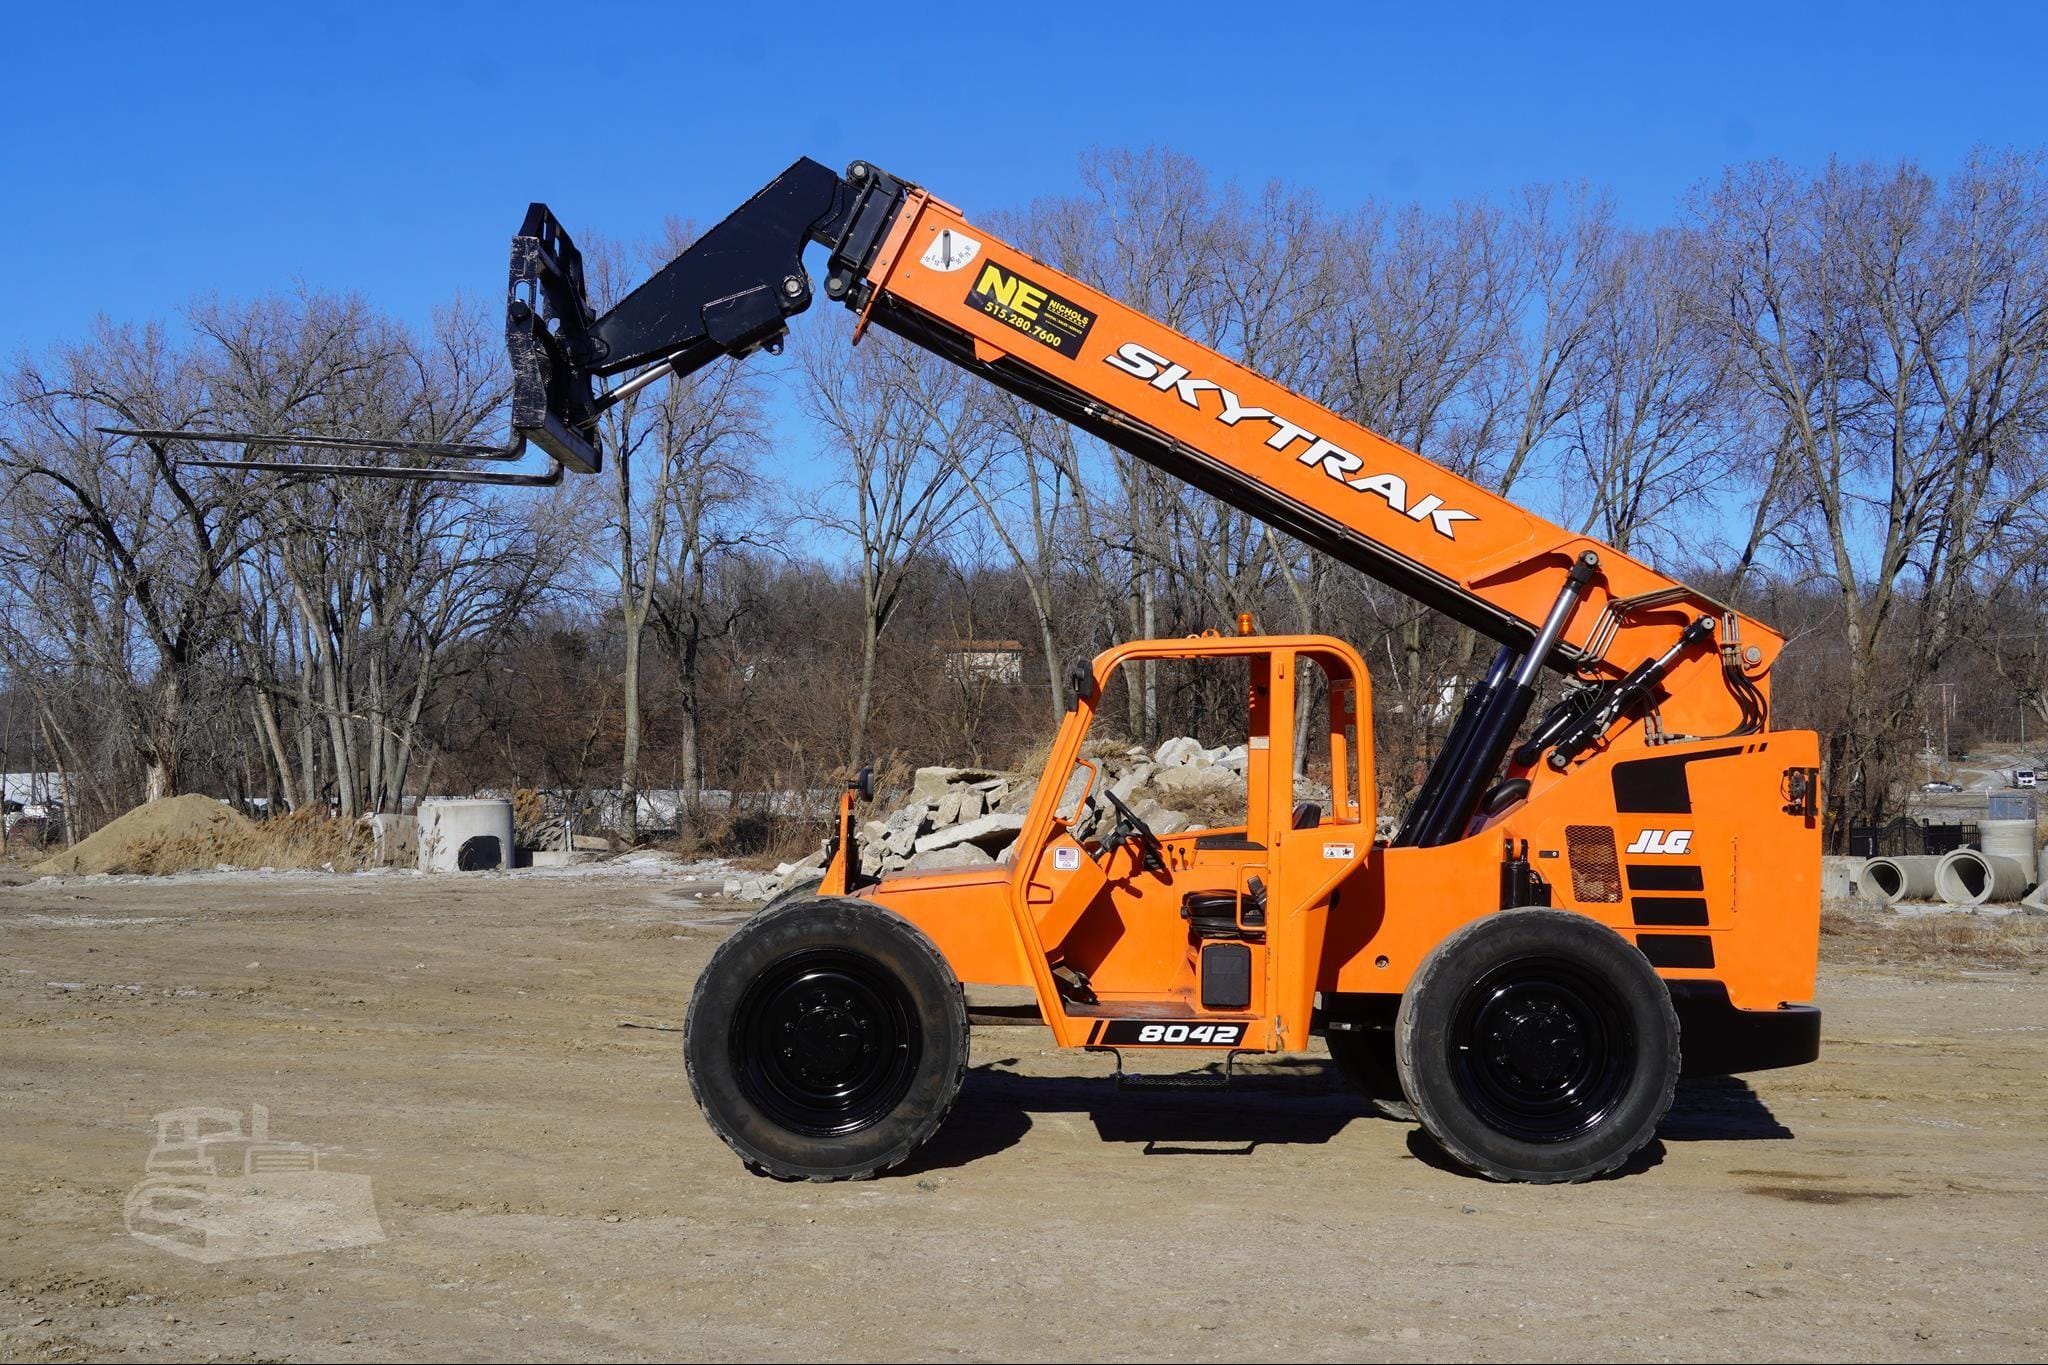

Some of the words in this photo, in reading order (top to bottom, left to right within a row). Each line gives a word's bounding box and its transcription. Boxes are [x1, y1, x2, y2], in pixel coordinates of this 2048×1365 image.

[976, 265, 1048, 321] NE
[984, 301, 1061, 347] 515.280.7600
[1048, 299, 1089, 325] NICHOLS
[1103, 342, 1481, 541] SKYTRAK
[1625, 829, 1693, 855] JLG
[1138, 1025, 1239, 1043] 8042
